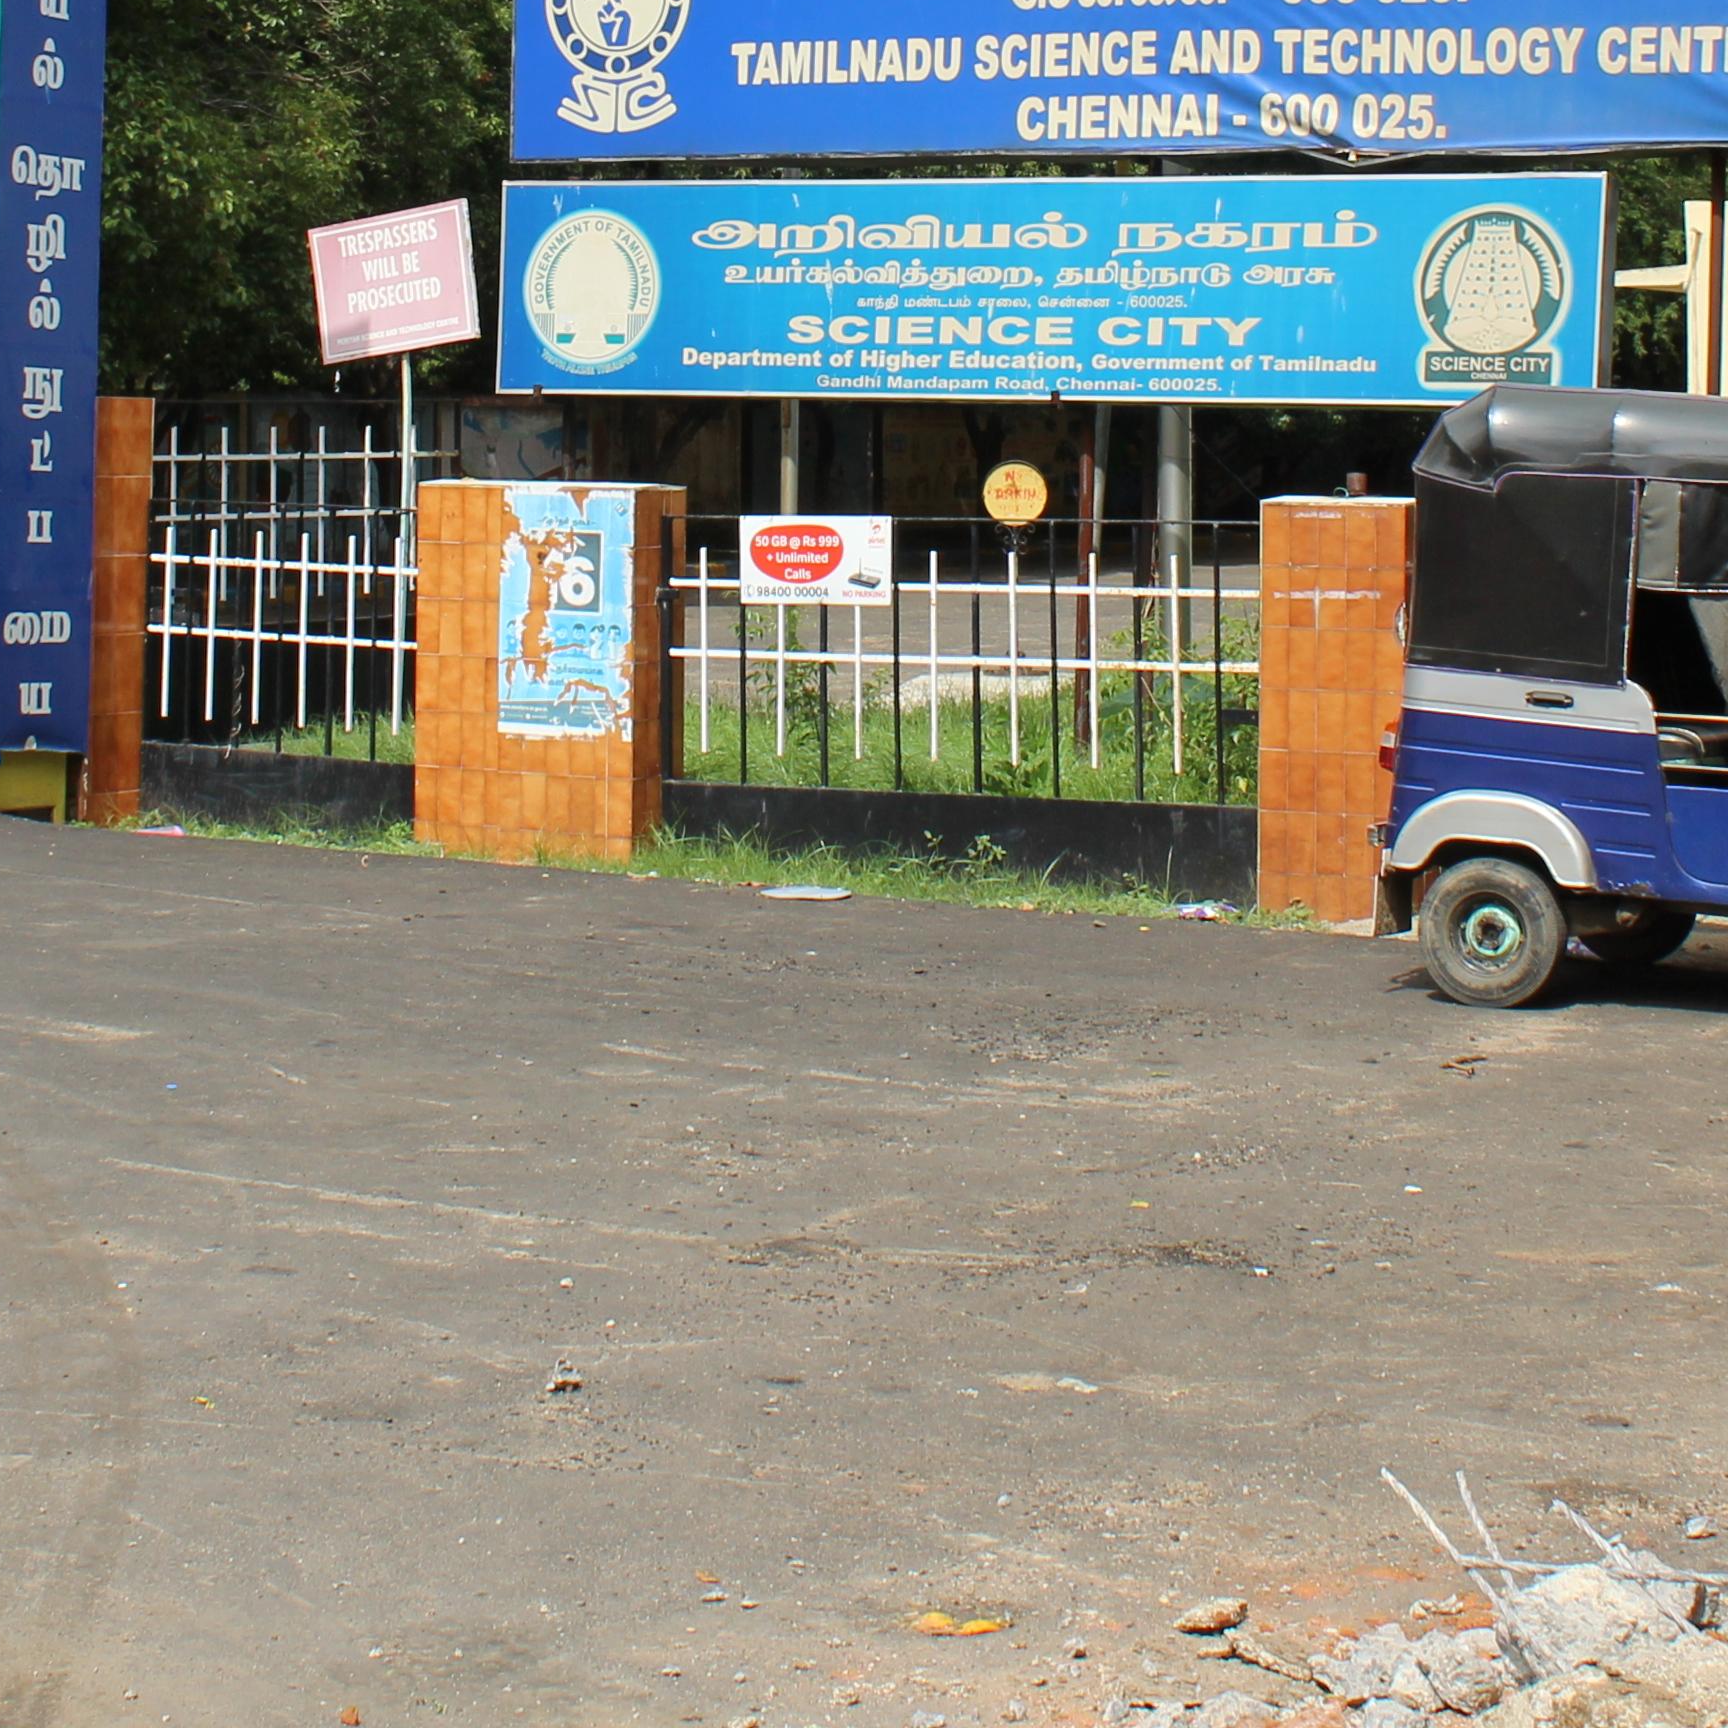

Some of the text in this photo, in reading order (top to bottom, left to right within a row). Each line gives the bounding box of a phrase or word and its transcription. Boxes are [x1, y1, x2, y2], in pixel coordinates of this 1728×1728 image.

[731, 37, 964, 86] TAMILNADU
[974, 30, 1158, 80] SCIENCE
[1169, 29, 1262, 75] AND
[1274, 26, 1585, 75] TECHNOLOGY
[1015, 93, 1220, 142] CHENNAI
[1258, 92, 1344, 139] 600
[1350, 93, 1448, 141] 025.
[337, 218, 438, 258] TRESPASSERS
[691, 209, 1379, 259] அறிவியல் நகரம்
[362, 251, 420, 282] WILL BE
[534, 220, 651, 308] GOVERNMENT OF TAMILNADU
[1053, 258, 1232, 292] தமிழ்நாடு
[1242, 262, 1336, 288] அரசு
[347, 277, 442, 314] PROSECUTED
[856, 294, 900, 310] காந்தி
[903, 294, 972, 309] மண்டபம்
[1037, 295, 1112, 309] சென்னை
[1130, 294, 1189, 309] 600025.
[787, 314, 1263, 347] SCIENCE CITY
[682, 347, 1378, 373] Department of Higher Education, Government of Tamilnadu
[1430, 356, 1550, 373] SCIENCE CITY
[816, 374, 881, 389] Gandhi
[887, 374, 990, 392] Mandapam
[994, 376, 1050, 392] Road,
[1148, 378, 1223, 392] 600025.
[1471, 372, 1508, 381] CHENNAI
[755, 535, 840, 550] 50 GB @ Rs 999
[766, 551, 829, 564] + Unlimited
[784, 567, 812, 580] Calls
[756, 585, 829, 598] 98400 00004
[842, 590, 887, 599] NO PARKING
